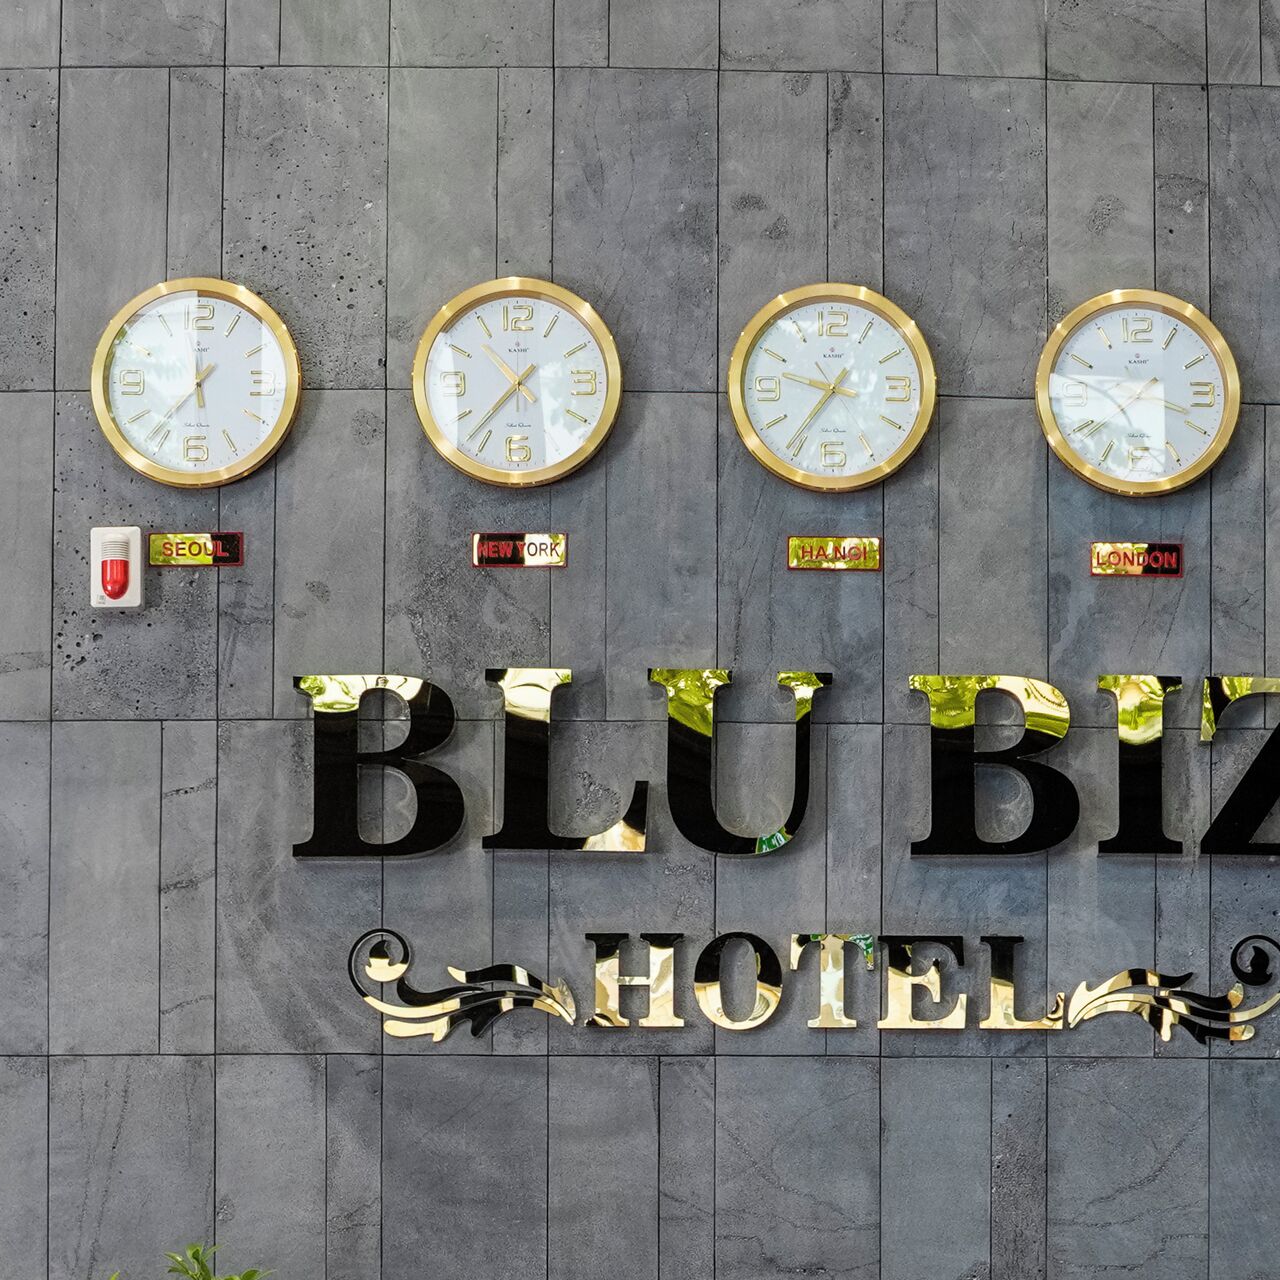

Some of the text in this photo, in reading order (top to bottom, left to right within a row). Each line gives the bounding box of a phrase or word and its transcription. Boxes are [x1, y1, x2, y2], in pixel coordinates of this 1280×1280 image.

[183, 303, 215, 332] 12
[502, 304, 534, 332] 12
[817, 310, 849, 337] 12
[1121, 317, 1153, 343] 12
[119, 369, 145, 396] 9
[249, 369, 276, 397] 3
[439, 370, 466, 397] 9
[570, 369, 597, 396] 3
[754, 375, 781, 402] 9
[885, 375, 912, 402] 3
[1061, 381, 1088, 407] 9
[1189, 381, 1216, 408] 3
[183, 435, 209, 462] 6
[505, 435, 532, 463] 6
[820, 441, 847, 468] 6
[161, 541, 229, 557] SEOUL
[477, 541, 560, 558] NEW YORK
[801, 545, 867, 561] HA NOI
[1096, 551, 1177, 568] LONDON
[293, 668, 833, 858] BLU
[584, 932, 1064, 1031] HOTEL
